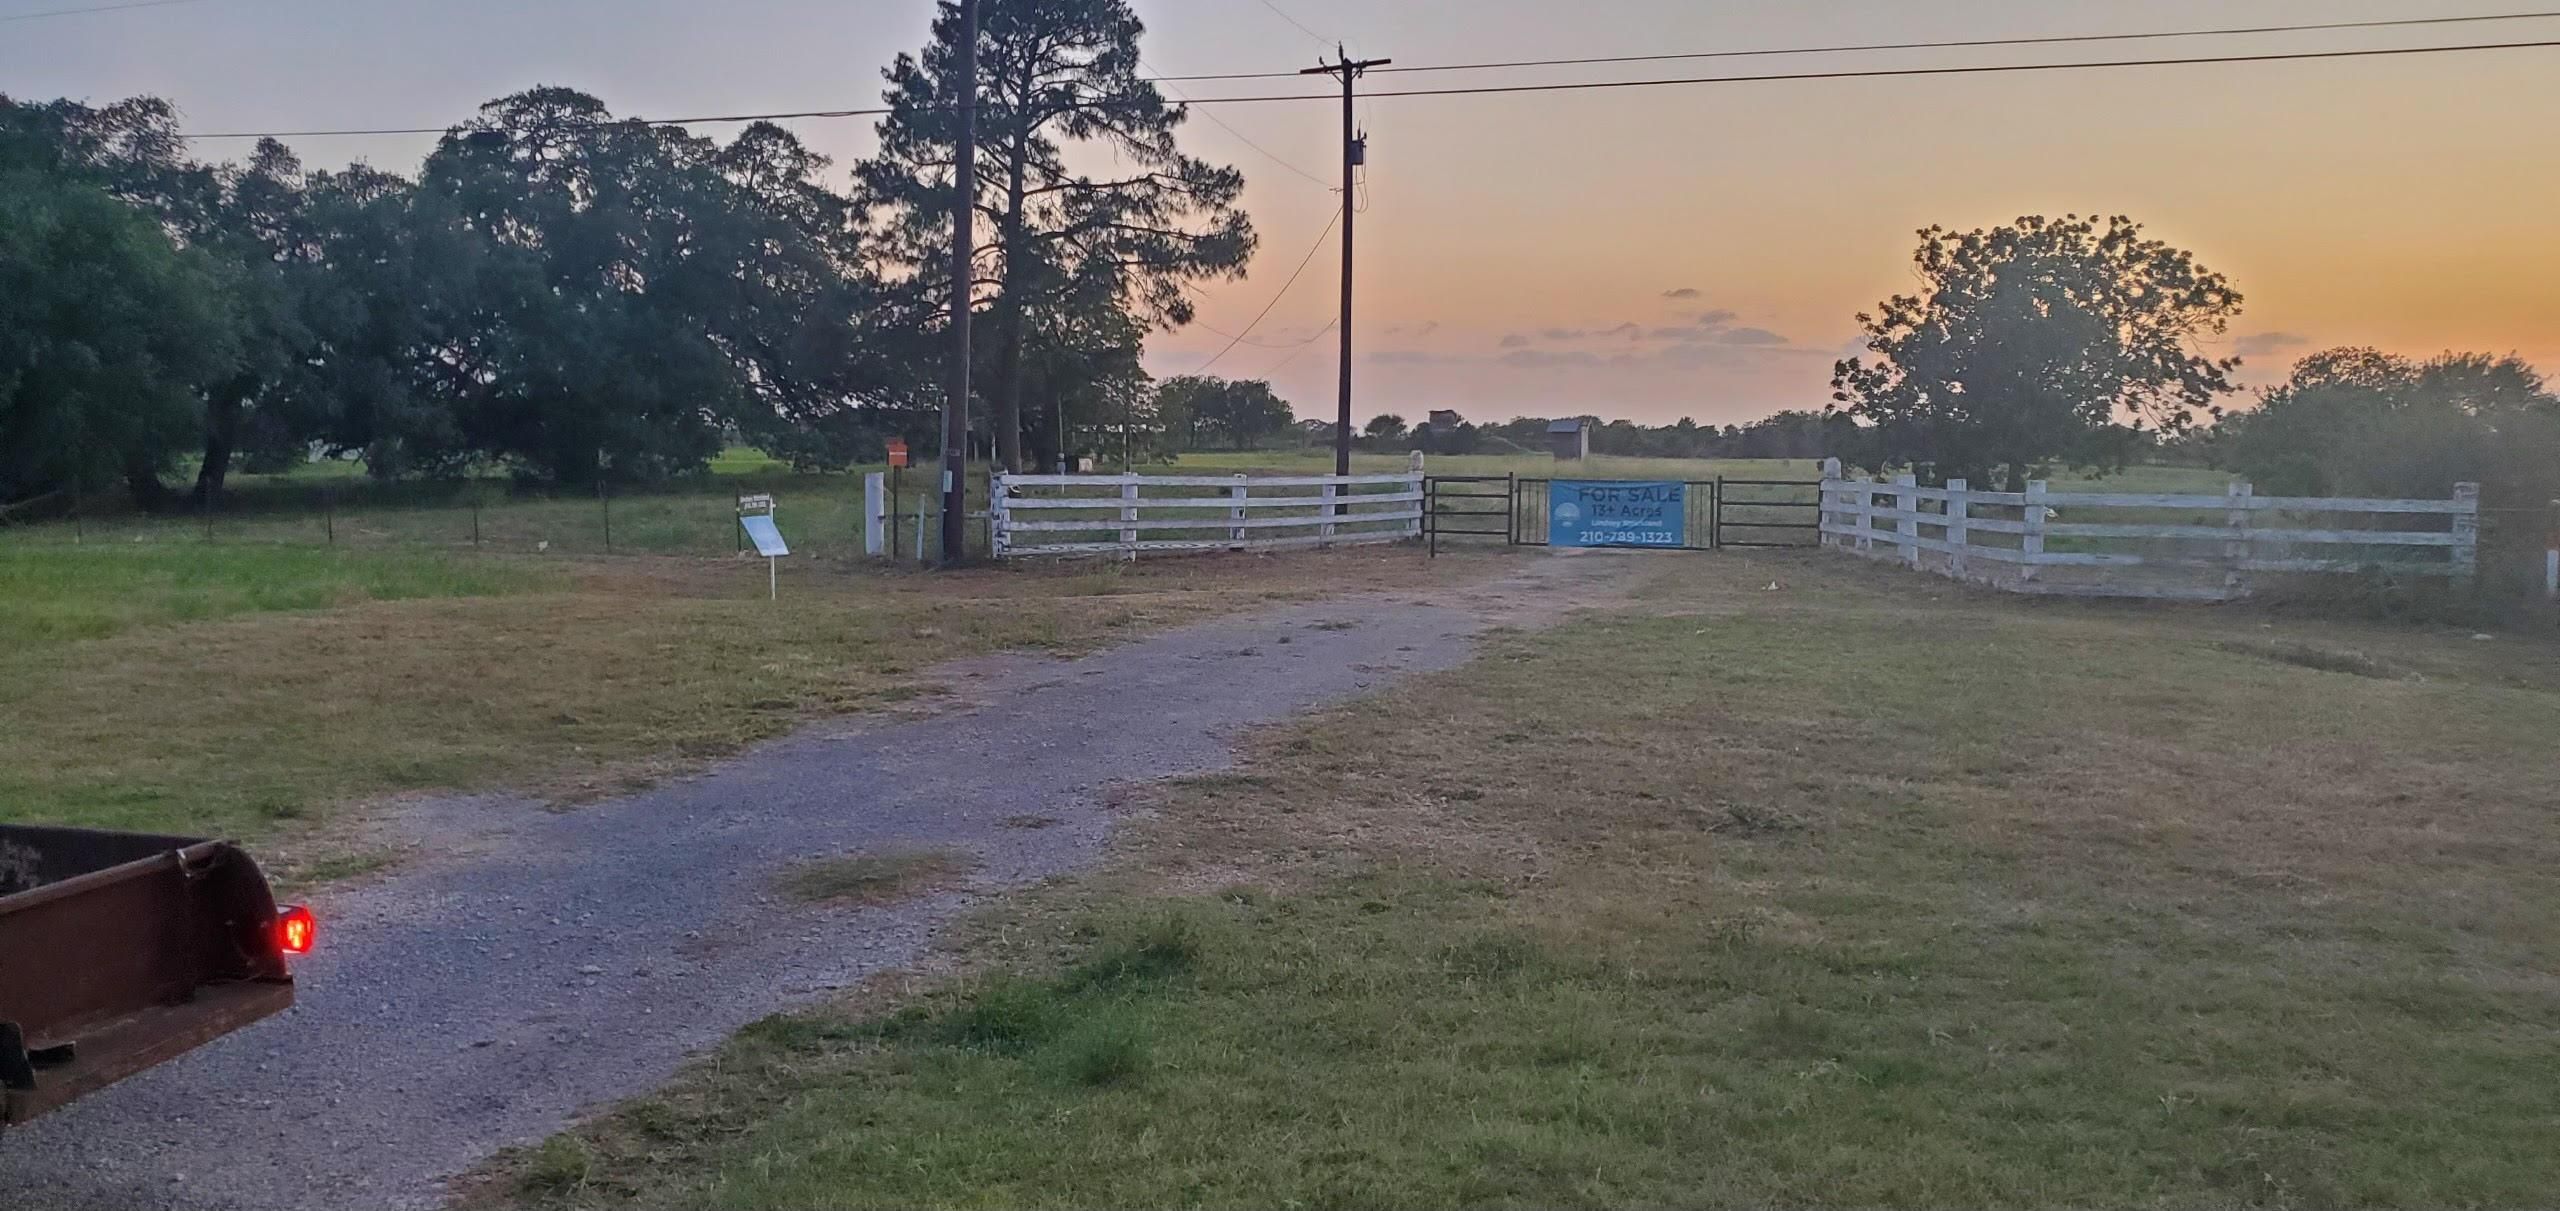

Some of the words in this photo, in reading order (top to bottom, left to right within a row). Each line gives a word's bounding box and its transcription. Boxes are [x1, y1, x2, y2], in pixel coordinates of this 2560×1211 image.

[1579, 487, 1620, 502] FOR
[1628, 487, 1681, 503] SALE
[1591, 504, 1615, 516] 13+
[1620, 504, 1663, 518] Acres
[1580, 531, 1673, 543] 210-789-1323
